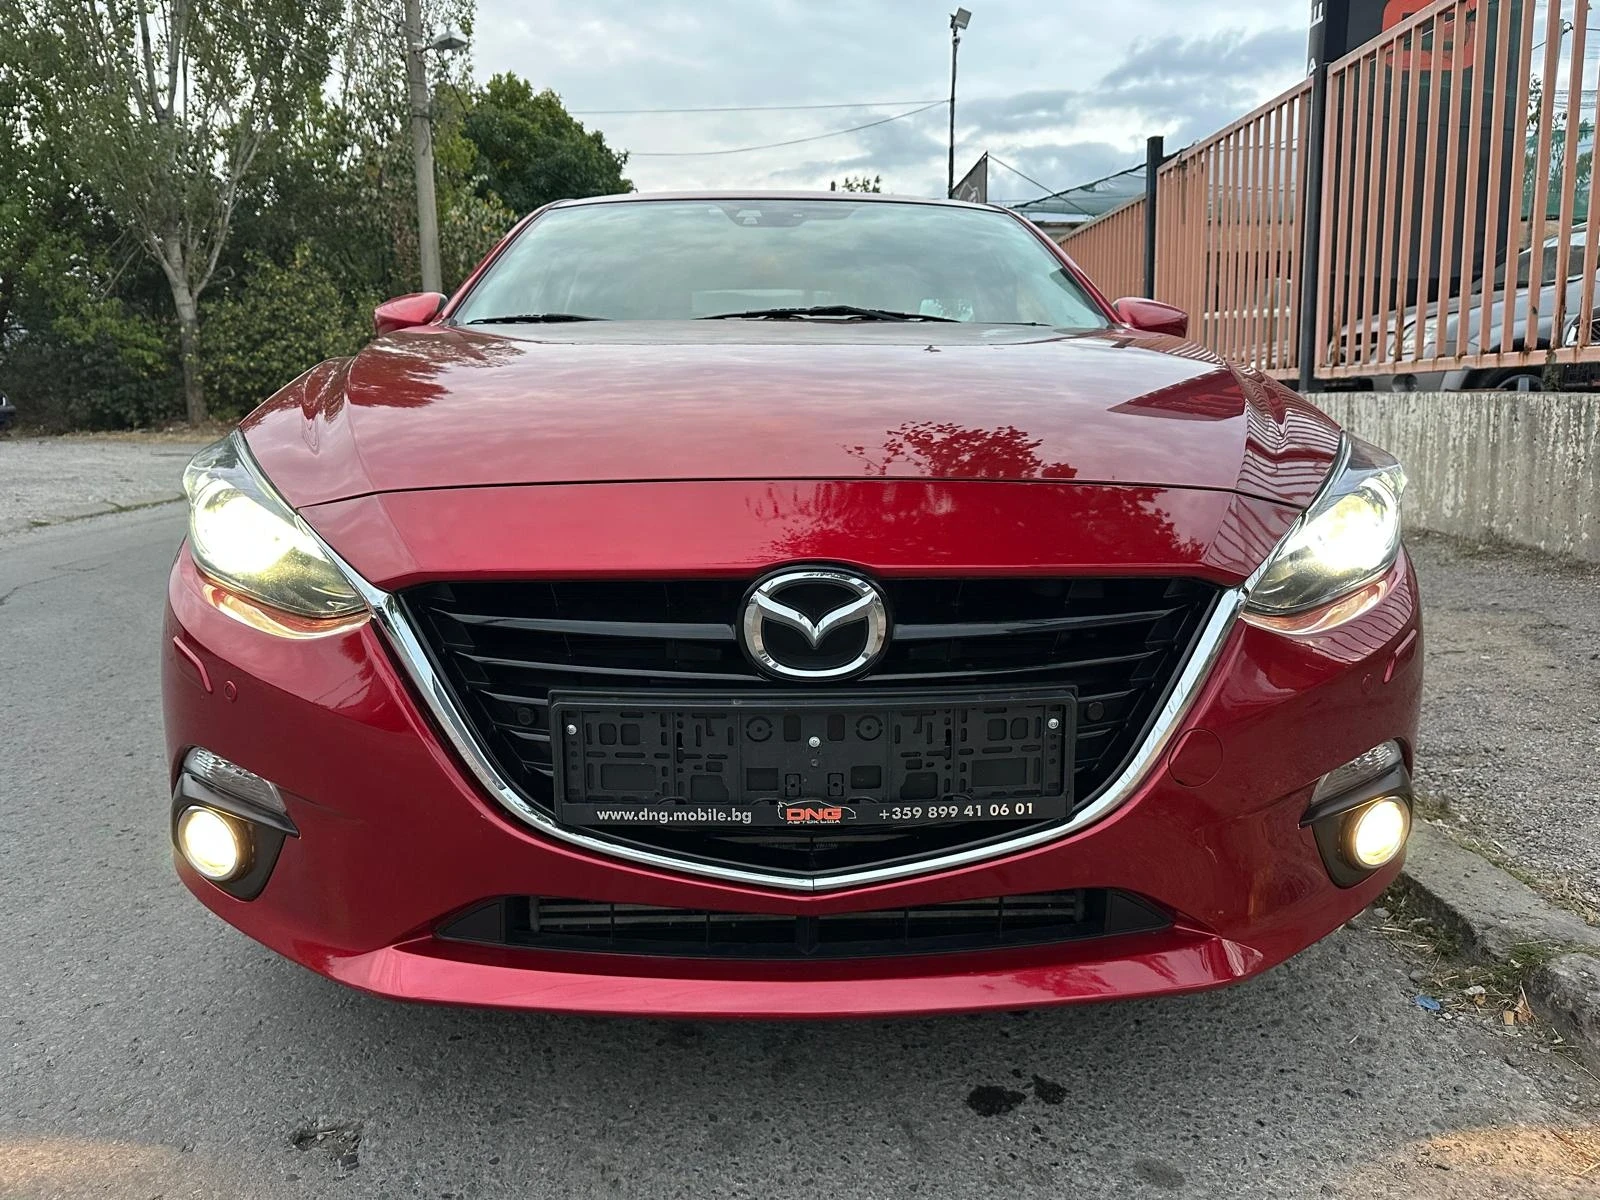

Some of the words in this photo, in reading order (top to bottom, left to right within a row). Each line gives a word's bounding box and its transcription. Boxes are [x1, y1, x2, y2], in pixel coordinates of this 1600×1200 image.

[597, 807, 752, 824] www.dng.mobile.bg
[786, 808, 842, 820] DNG
[879, 806, 922, 820] +359
[927, 805, 958, 818] 899
[963, 805, 982, 817] 41
[989, 804, 1009, 816] 06
[1015, 803, 1033, 815] 01
